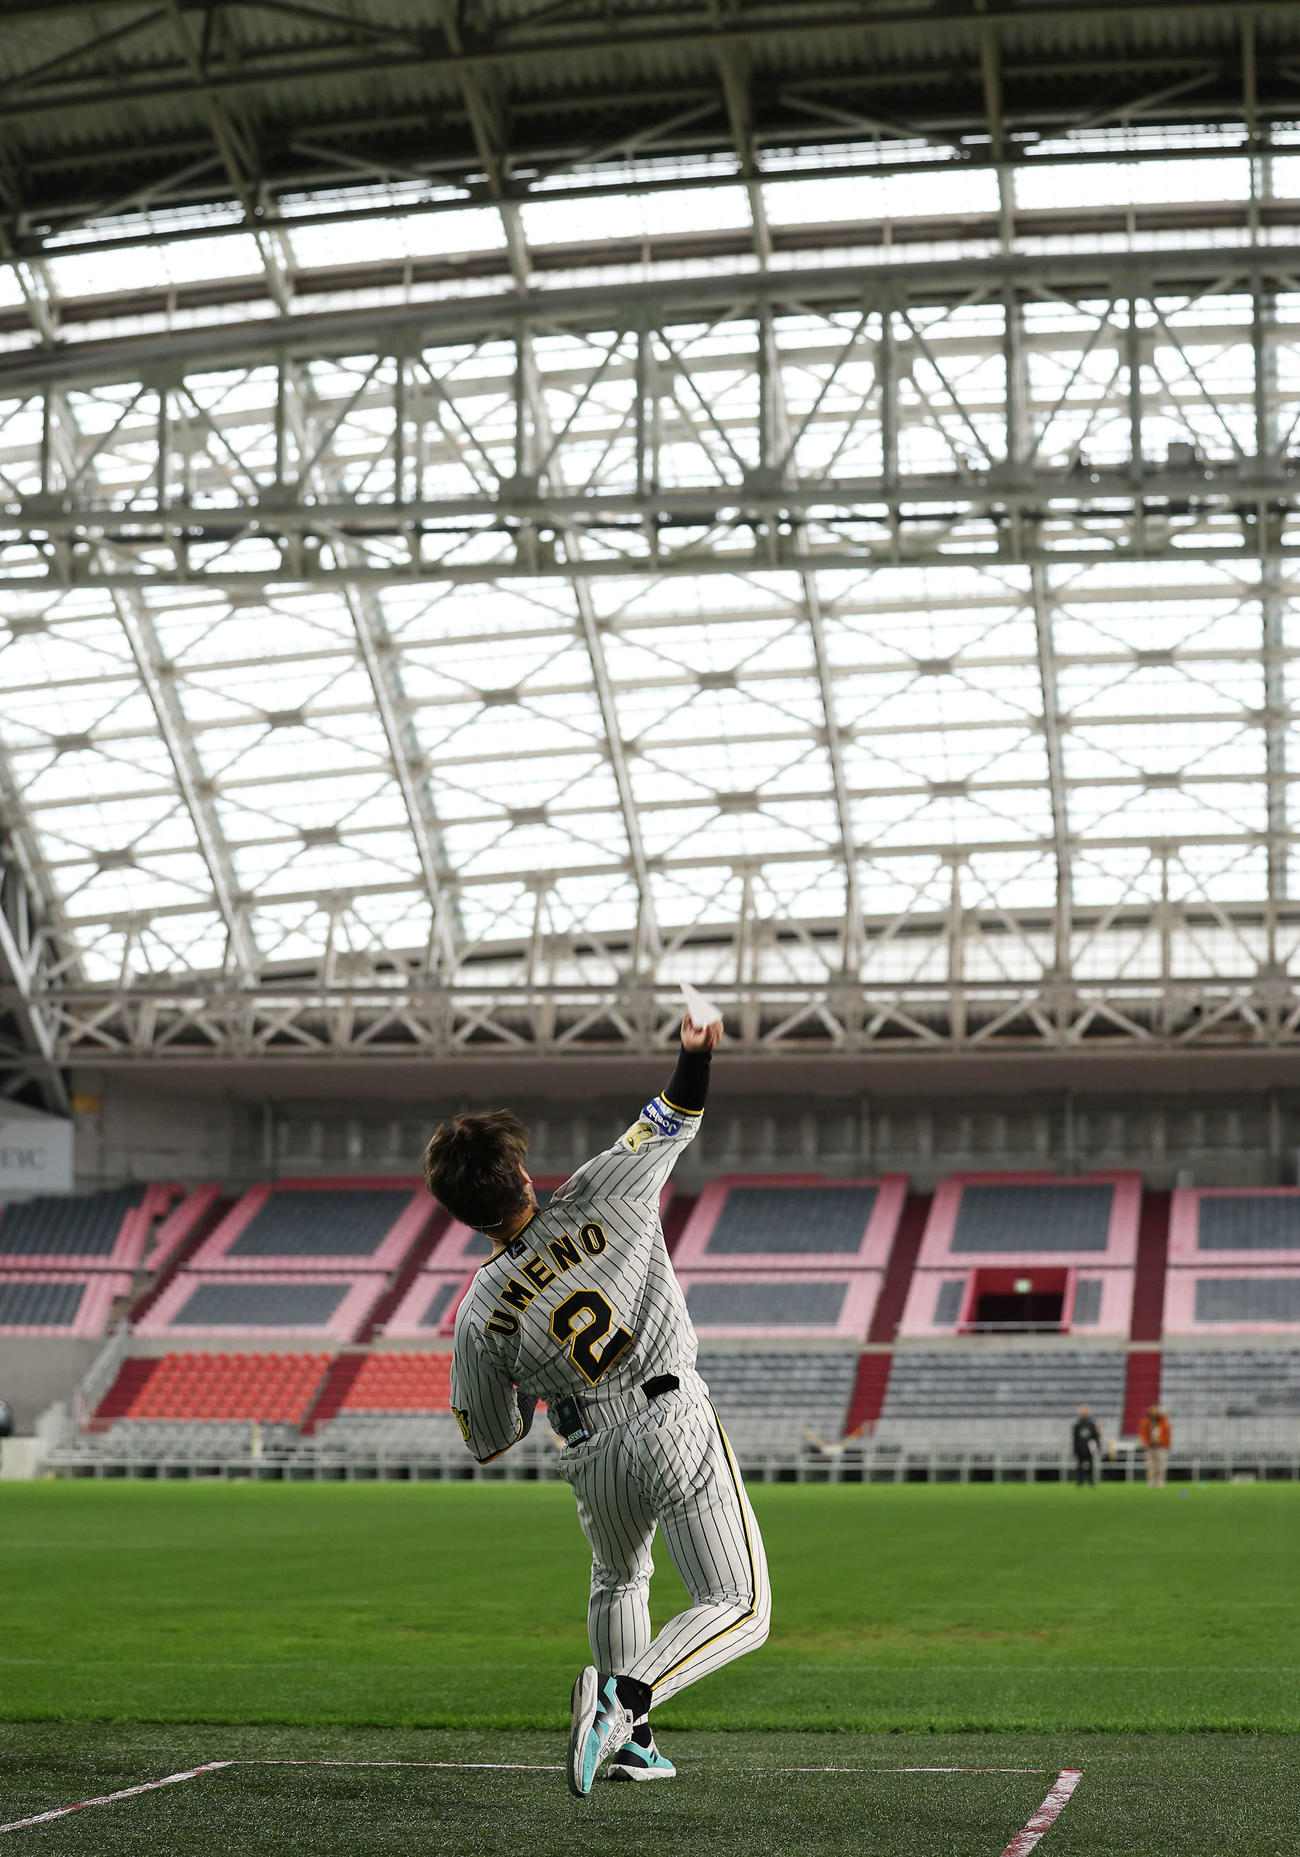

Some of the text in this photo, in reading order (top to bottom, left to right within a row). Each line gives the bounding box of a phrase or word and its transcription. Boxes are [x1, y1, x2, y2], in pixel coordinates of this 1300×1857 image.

[646, 1103, 677, 1133] Joshin
[485, 1222, 608, 1338] UMENO
[550, 1289, 634, 1386] 2
